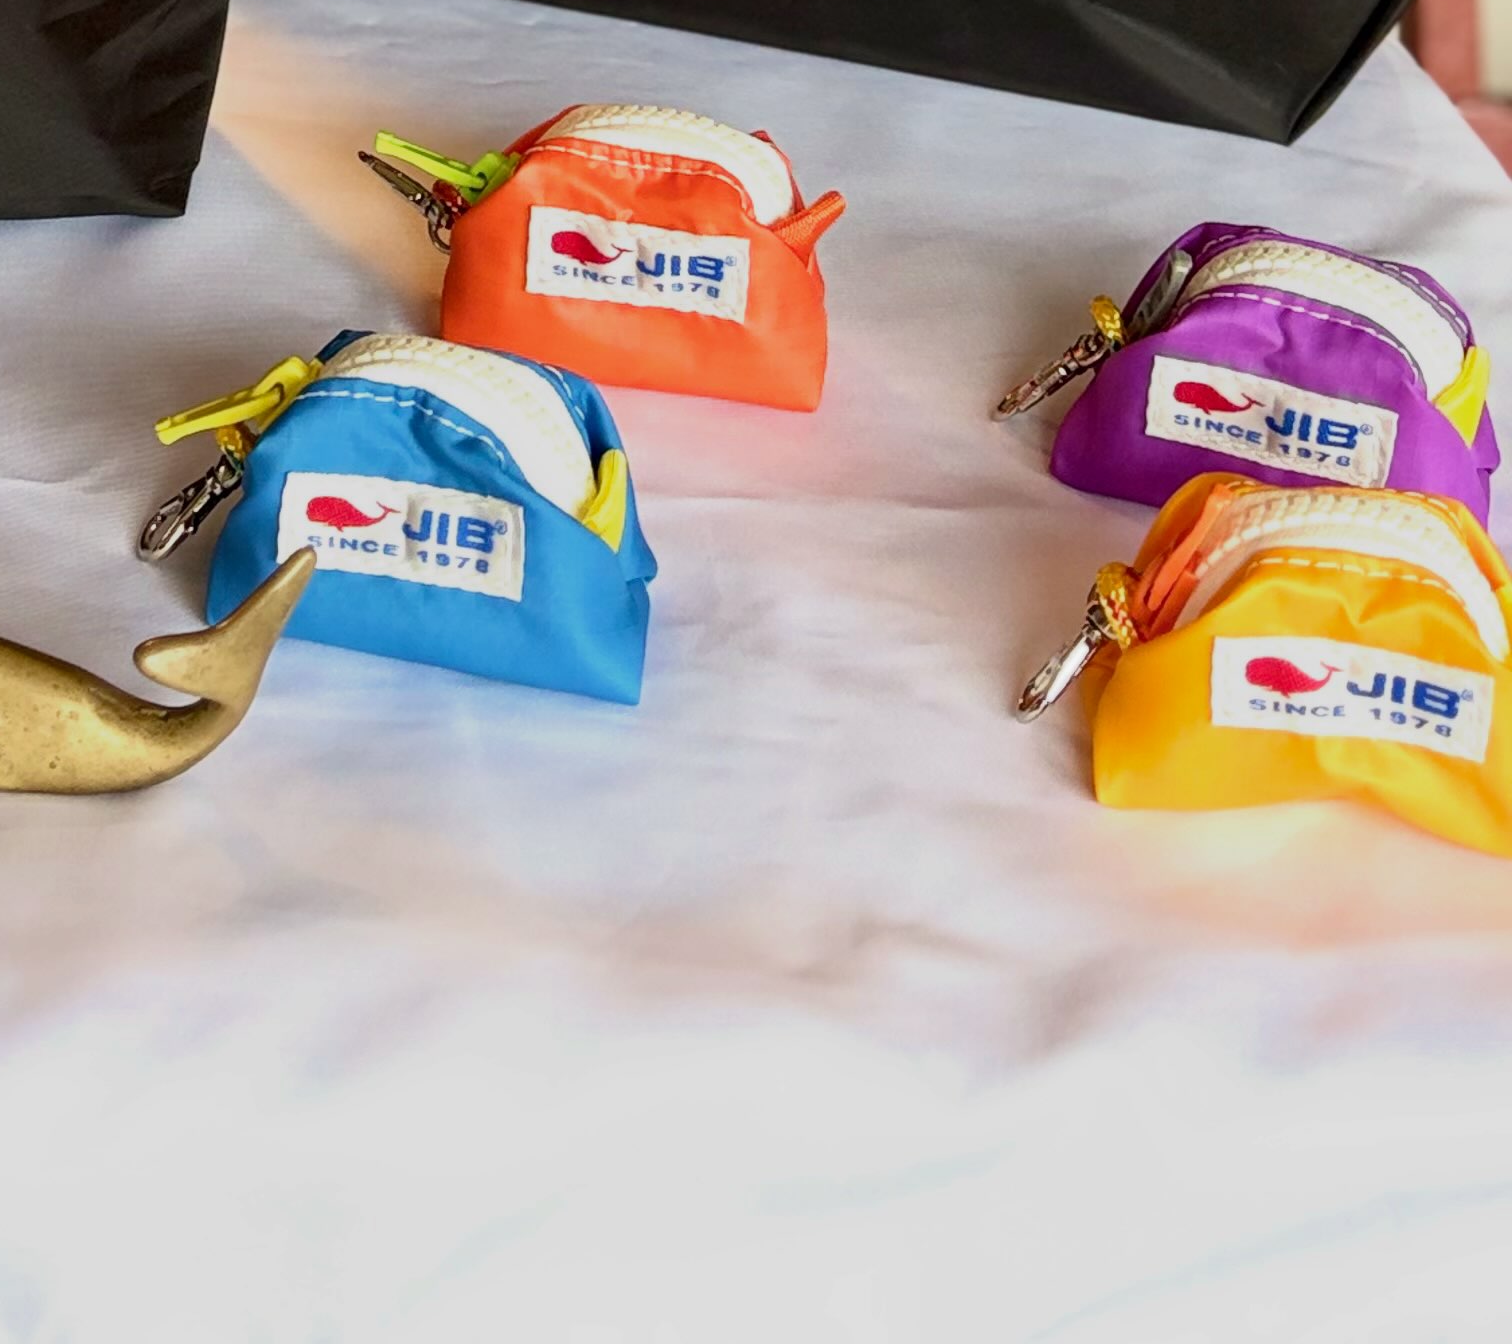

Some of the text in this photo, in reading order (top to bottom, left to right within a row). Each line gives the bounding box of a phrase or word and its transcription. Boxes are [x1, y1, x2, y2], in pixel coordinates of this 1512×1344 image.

[552, 264, 720, 299] SINCE 1978
[636, 252, 724, 282] JIB
[1174, 414, 1350, 467] SINCE 1978
[1265, 408, 1359, 449] JIB
[402, 510, 495, 554] JIB
[307, 535, 490, 574] SINCE 1978
[1346, 673, 1460, 719] JIB
[1249, 698, 1452, 738] SINCE 1978
